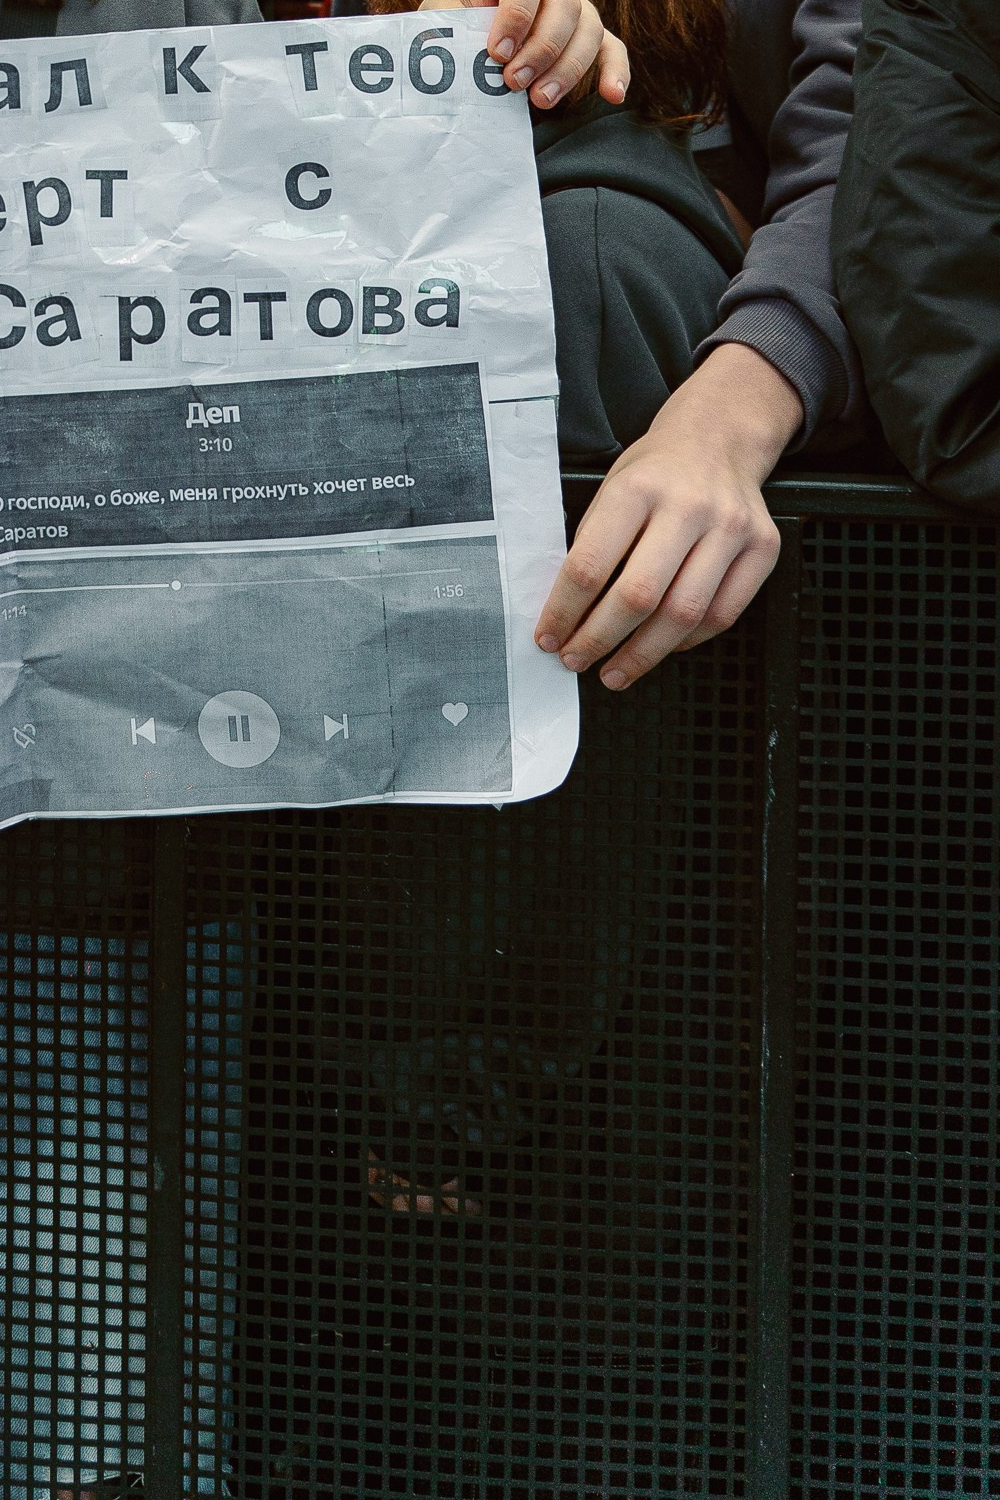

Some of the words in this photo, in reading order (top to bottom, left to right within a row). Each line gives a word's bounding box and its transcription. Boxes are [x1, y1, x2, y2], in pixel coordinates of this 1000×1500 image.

[162, 45, 212, 95] к
[285, 27, 512, 97] тебе
[285, 162, 332, 210] с
[186, 402, 241, 428] Деп
[199, 438, 233, 452] 3:10
[8, 494, 91, 511] господи,
[94, 494, 106, 507] о
[110, 488, 165, 507] боже,
[169, 486, 218, 502] меня
[222, 483, 309, 503] грохнуть
[313, 477, 367, 496] хочет
[371, 473, 415, 490] весь
[432, 584, 464, 599] 1:56
[1, 605, 28, 621] 1:14
